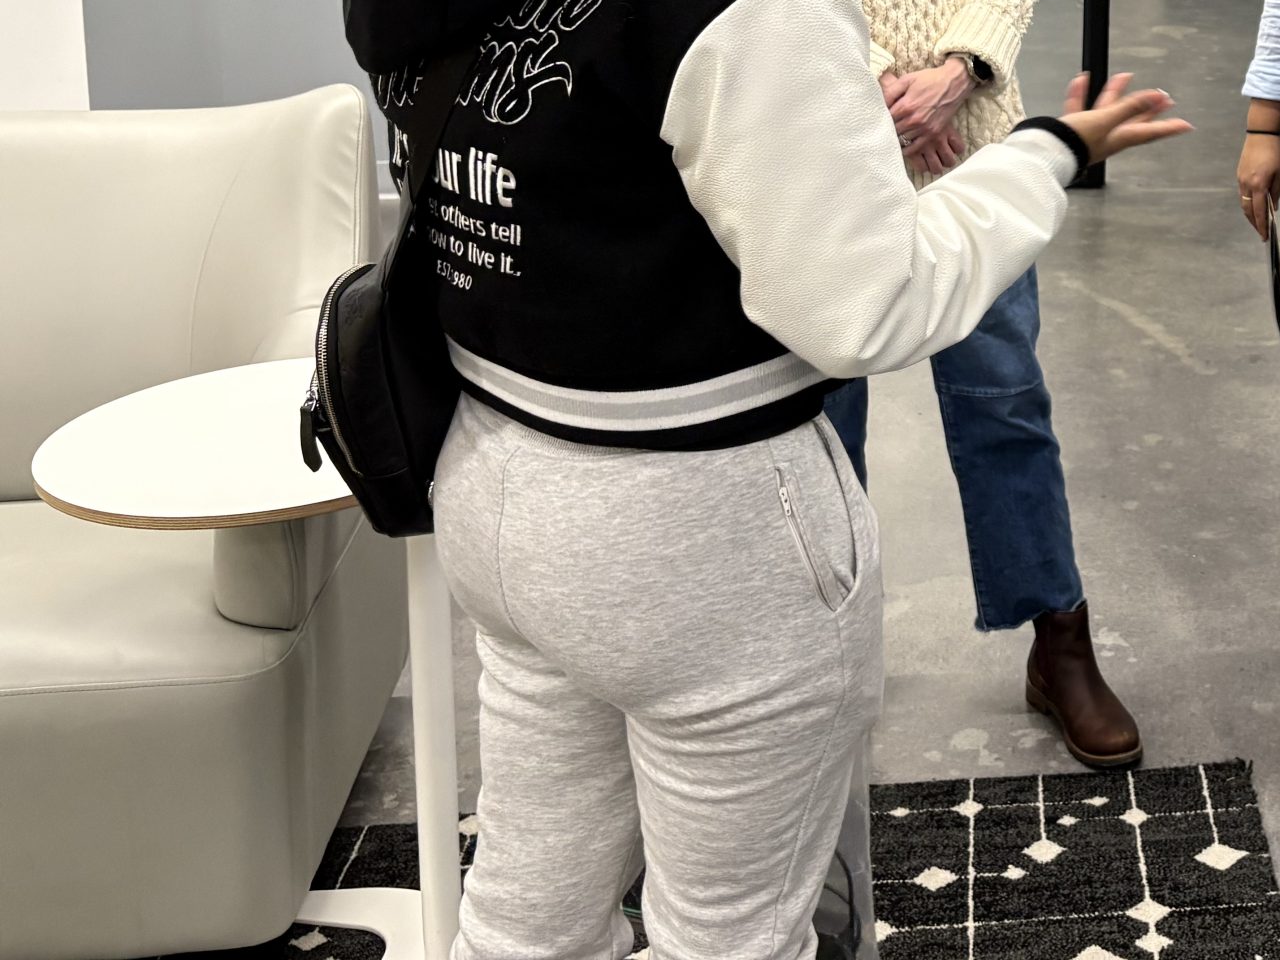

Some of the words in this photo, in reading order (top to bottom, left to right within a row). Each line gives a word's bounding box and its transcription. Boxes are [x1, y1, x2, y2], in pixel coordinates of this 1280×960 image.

[469, 146, 517, 208] life
[441, 205, 486, 237] others
[490, 221, 522, 247] tell
[450, 235, 464, 257] to
[468, 241, 495, 270] live
